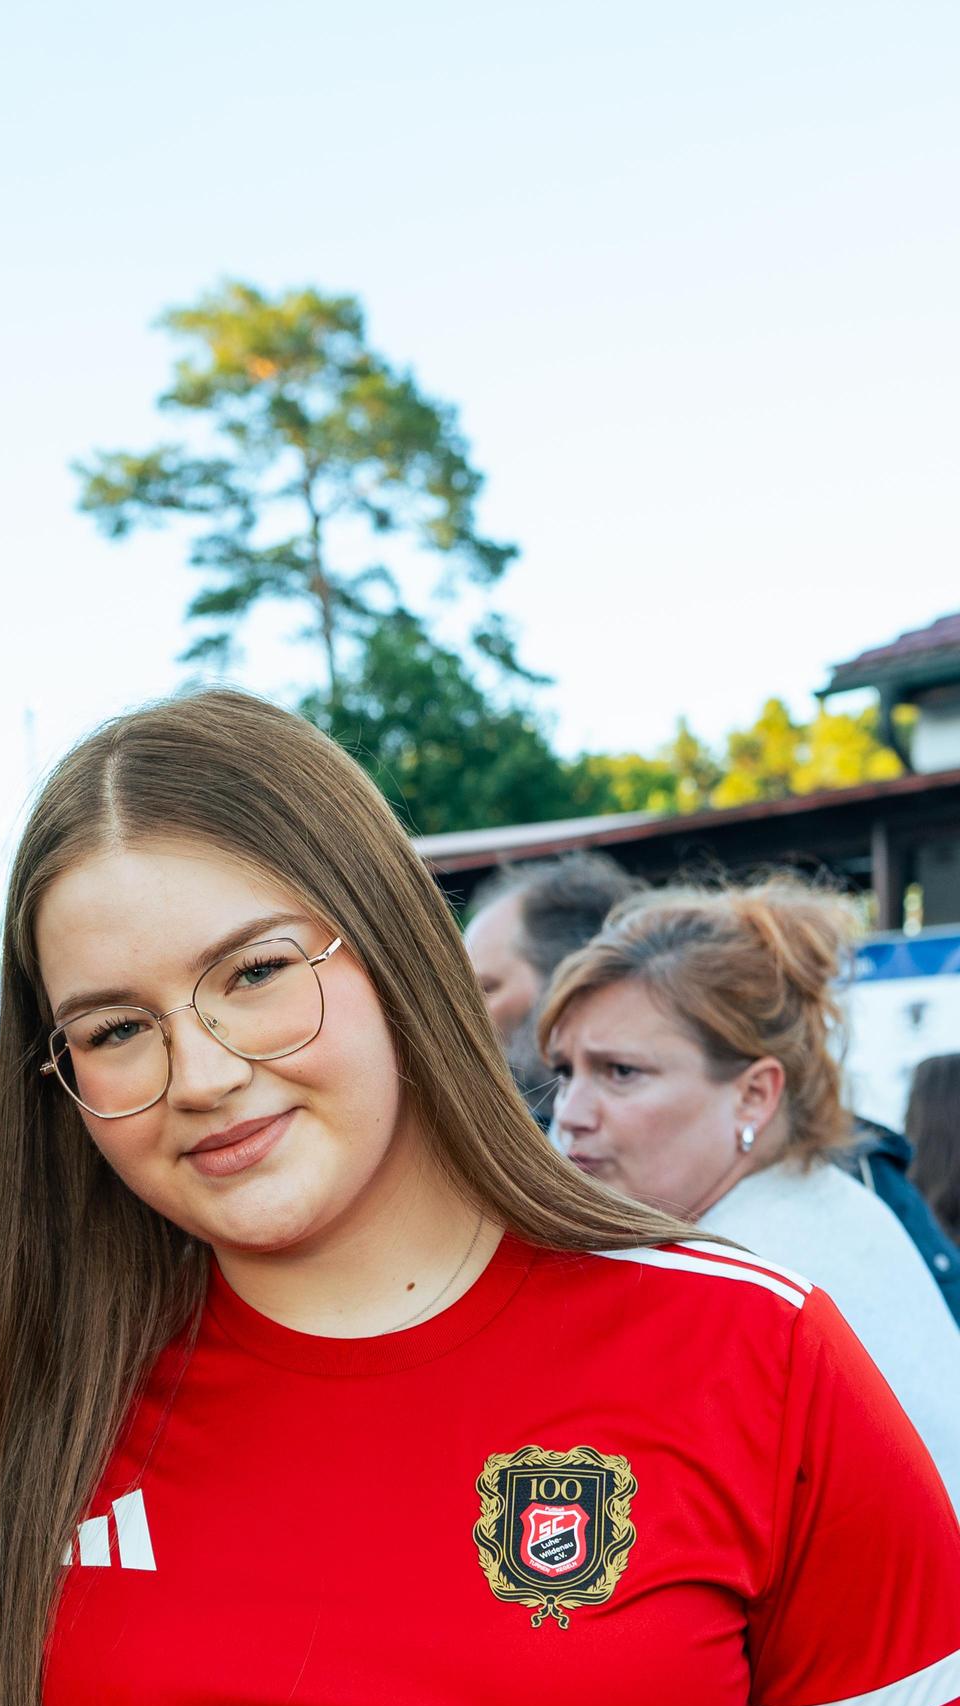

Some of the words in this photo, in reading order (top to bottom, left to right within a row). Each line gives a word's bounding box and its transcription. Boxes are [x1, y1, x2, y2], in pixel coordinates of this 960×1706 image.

[529, 1477, 582, 1500] 100
[539, 1515, 565, 1540] SC
[539, 1541, 574, 1559] Wildenau
[540, 1538, 562, 1549] Luhe-
[553, 1552, 568, 1561] e.V.
